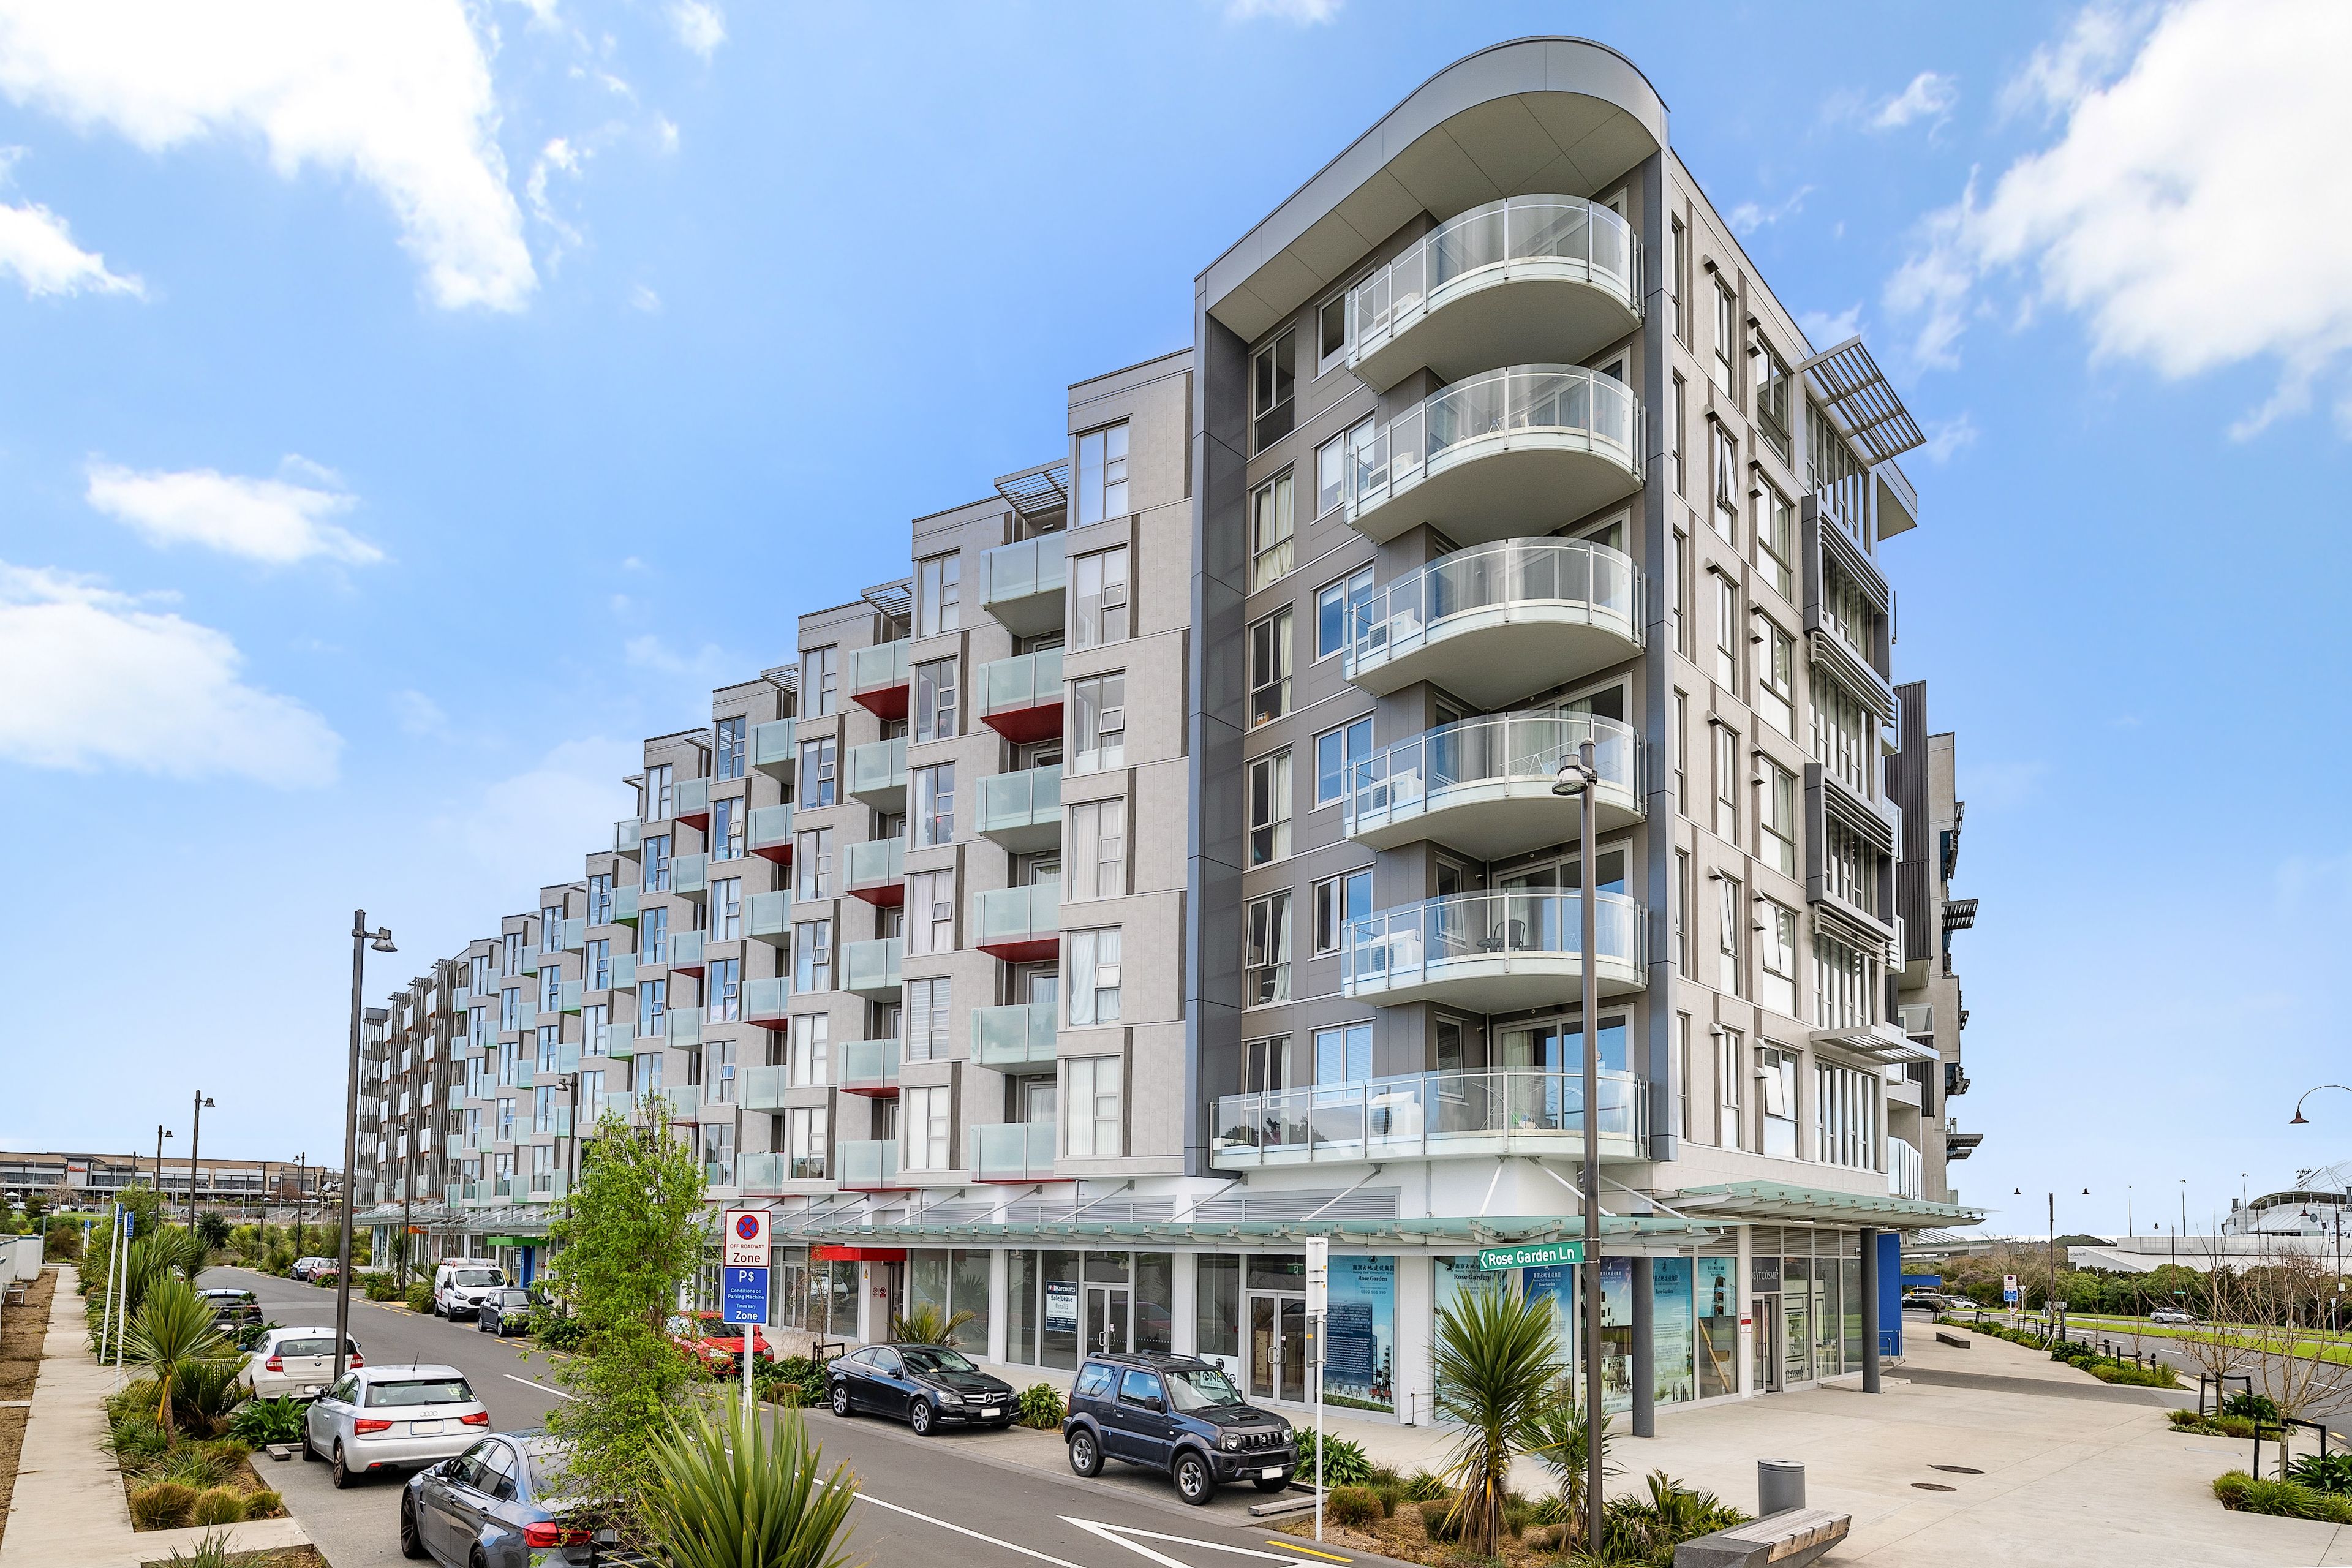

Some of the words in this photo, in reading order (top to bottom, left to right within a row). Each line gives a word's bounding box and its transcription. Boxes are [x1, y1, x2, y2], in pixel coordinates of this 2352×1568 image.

[733, 1253, 761, 1263] Zone
[1488, 1253, 1513, 1266] Rose
[1517, 1249, 1556, 1264] Garden
[1559, 1246, 1575, 1261] Ln
[739, 1270, 755, 1283] P$
[736, 1311, 758, 1320] Zone
